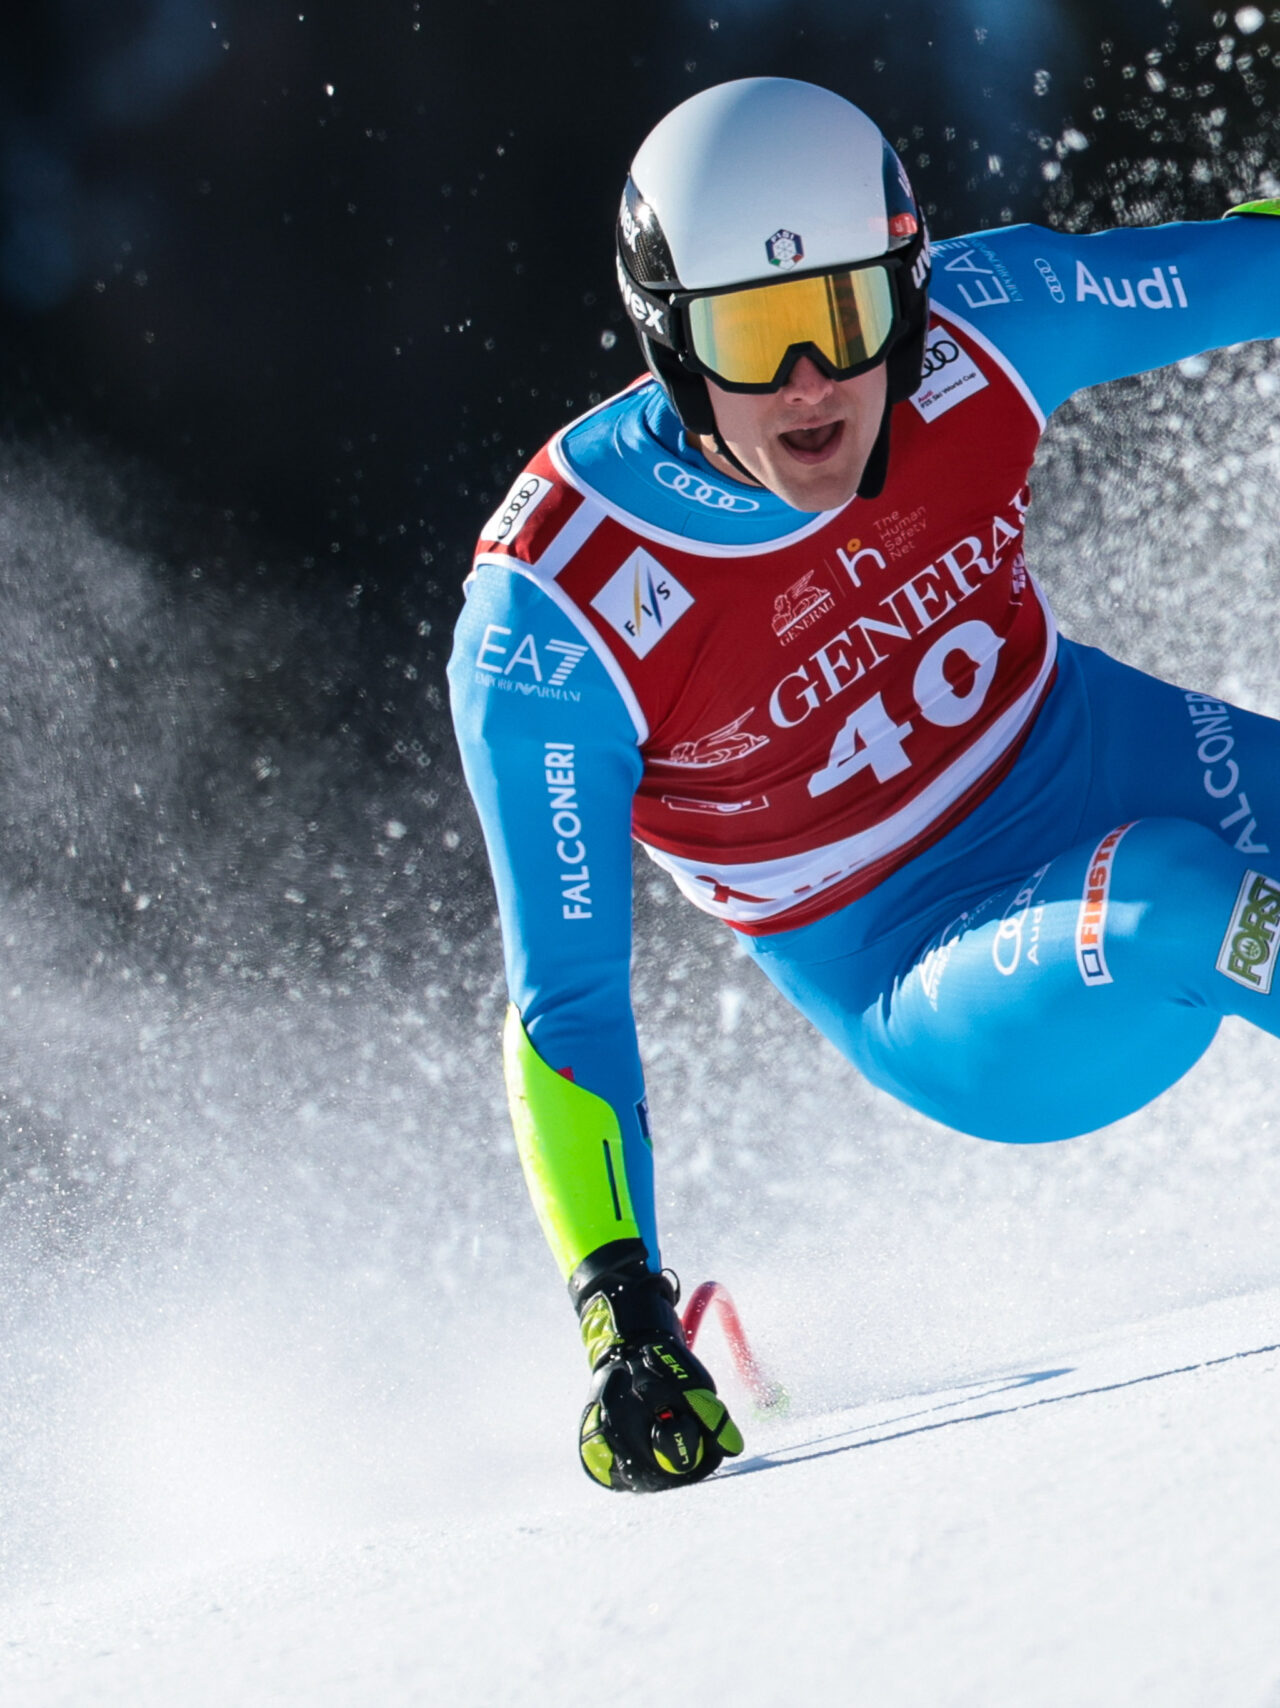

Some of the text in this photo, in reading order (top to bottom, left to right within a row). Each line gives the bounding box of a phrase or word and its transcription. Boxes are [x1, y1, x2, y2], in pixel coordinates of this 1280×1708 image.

[1075, 260, 1189, 309] Audi
[873, 511, 900, 530] The
[880, 506, 927, 540] Human
[884, 518, 927, 552] Safety
[889, 540, 917, 562] Net
[623, 580, 672, 637] FIS
[780, 597, 837, 647] GENERALI
[475, 623, 590, 687] EA7
[807, 619, 1007, 799] 40
[544, 741, 593, 920] FALCONERI
[652, 1345, 689, 1379] LEKI
[673, 1432, 690, 1465] LEKI
